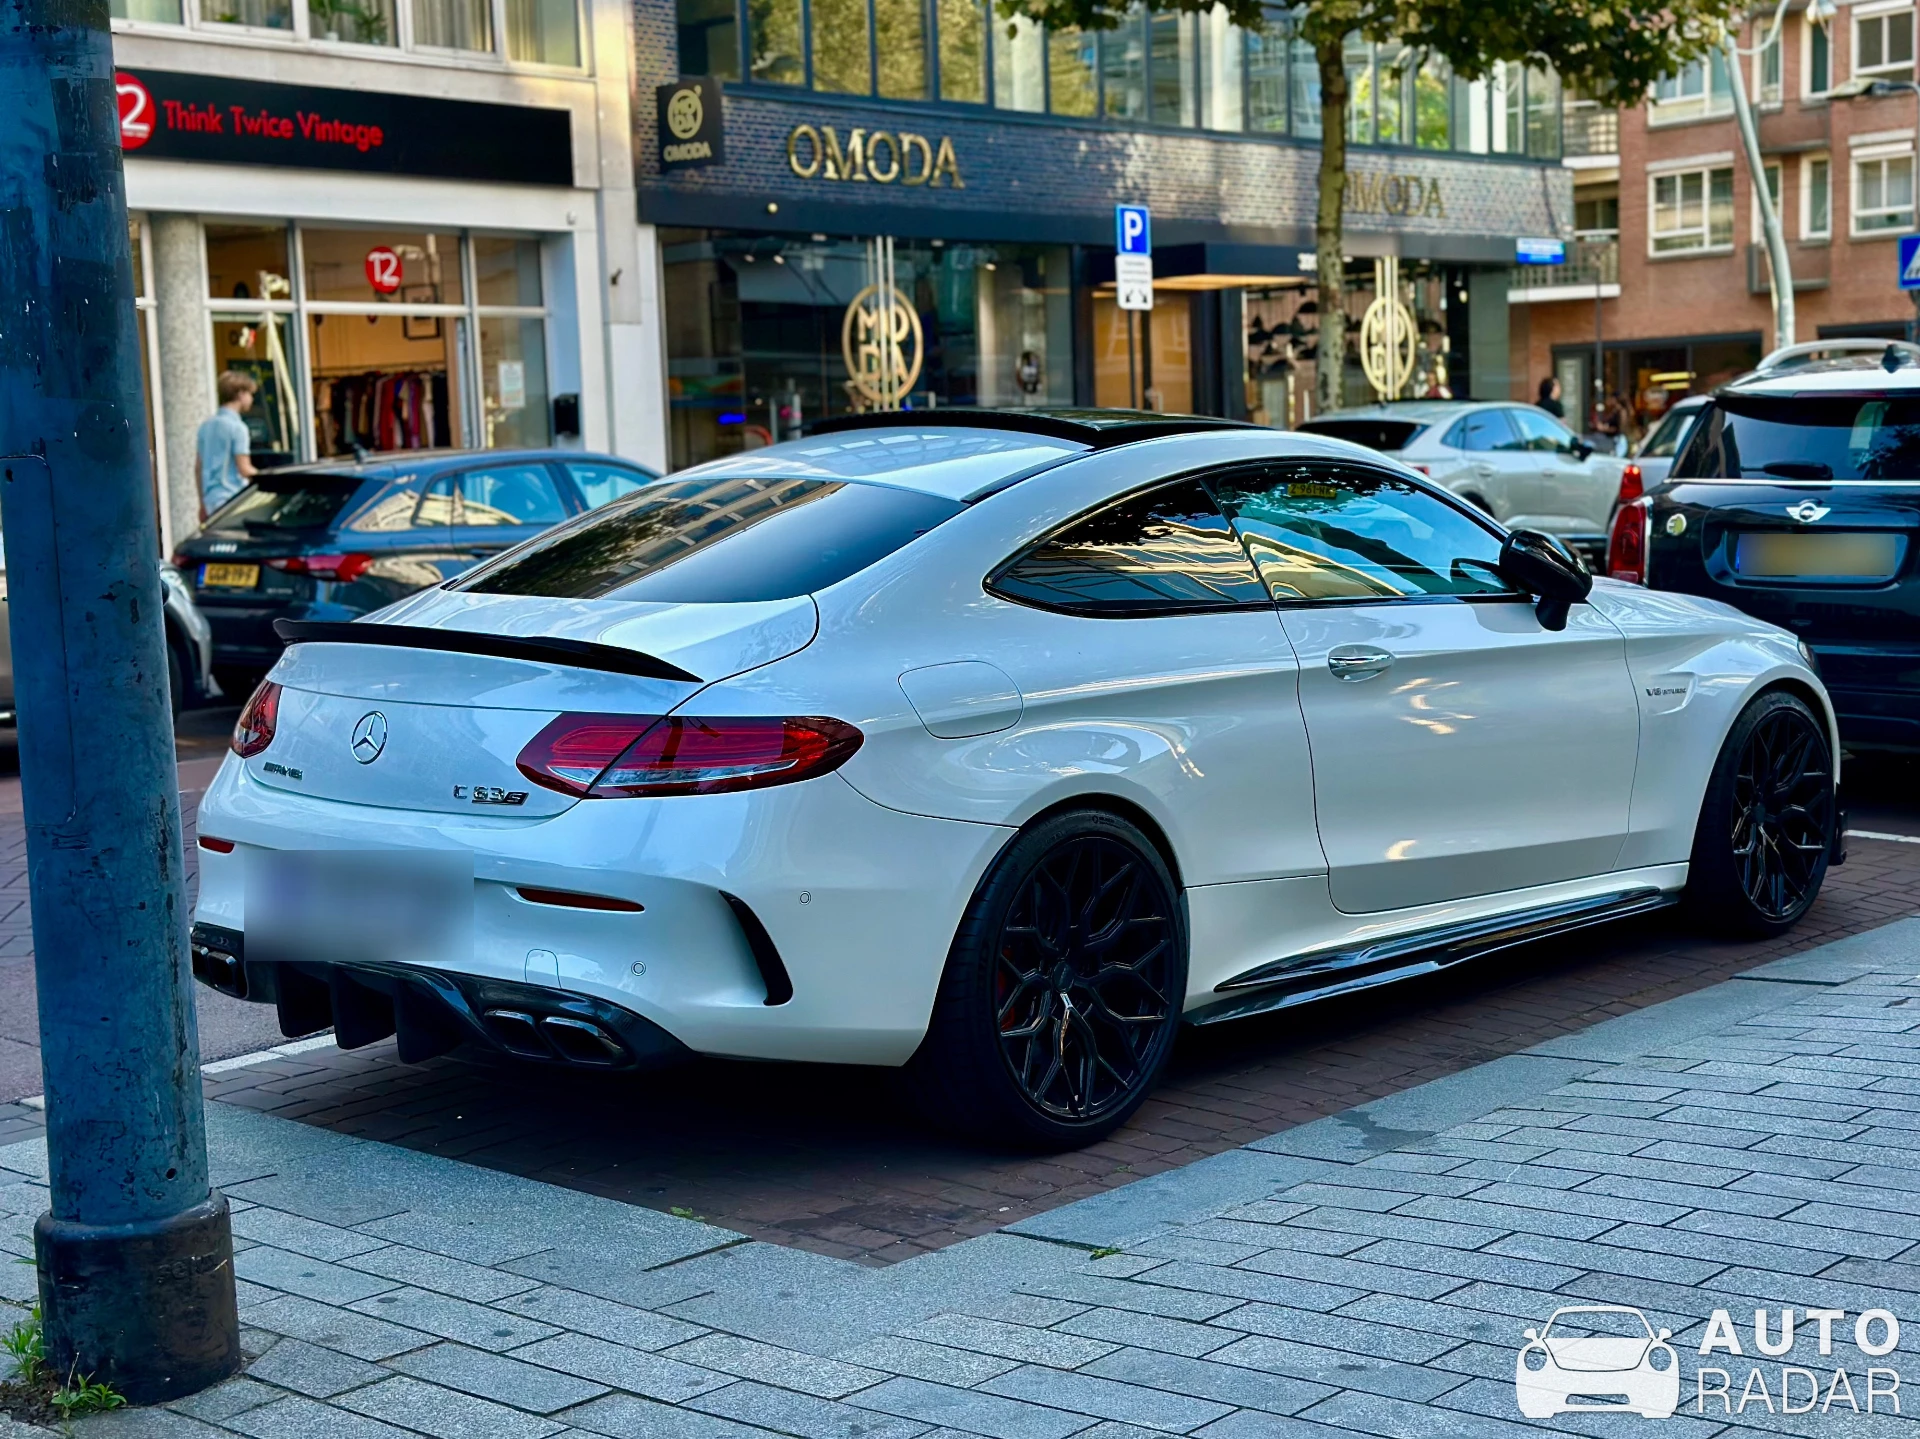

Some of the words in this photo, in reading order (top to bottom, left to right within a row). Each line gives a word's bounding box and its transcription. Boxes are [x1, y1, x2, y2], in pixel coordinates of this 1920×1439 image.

[116, 83, 149, 132] 2
[163, 100, 223, 133] Think
[230, 105, 294, 139] Twice
[297, 110, 384, 152] Vintage
[663, 142, 712, 162] OMODA
[787, 124, 966, 189] OMODA
[1124, 210, 1144, 251] P
